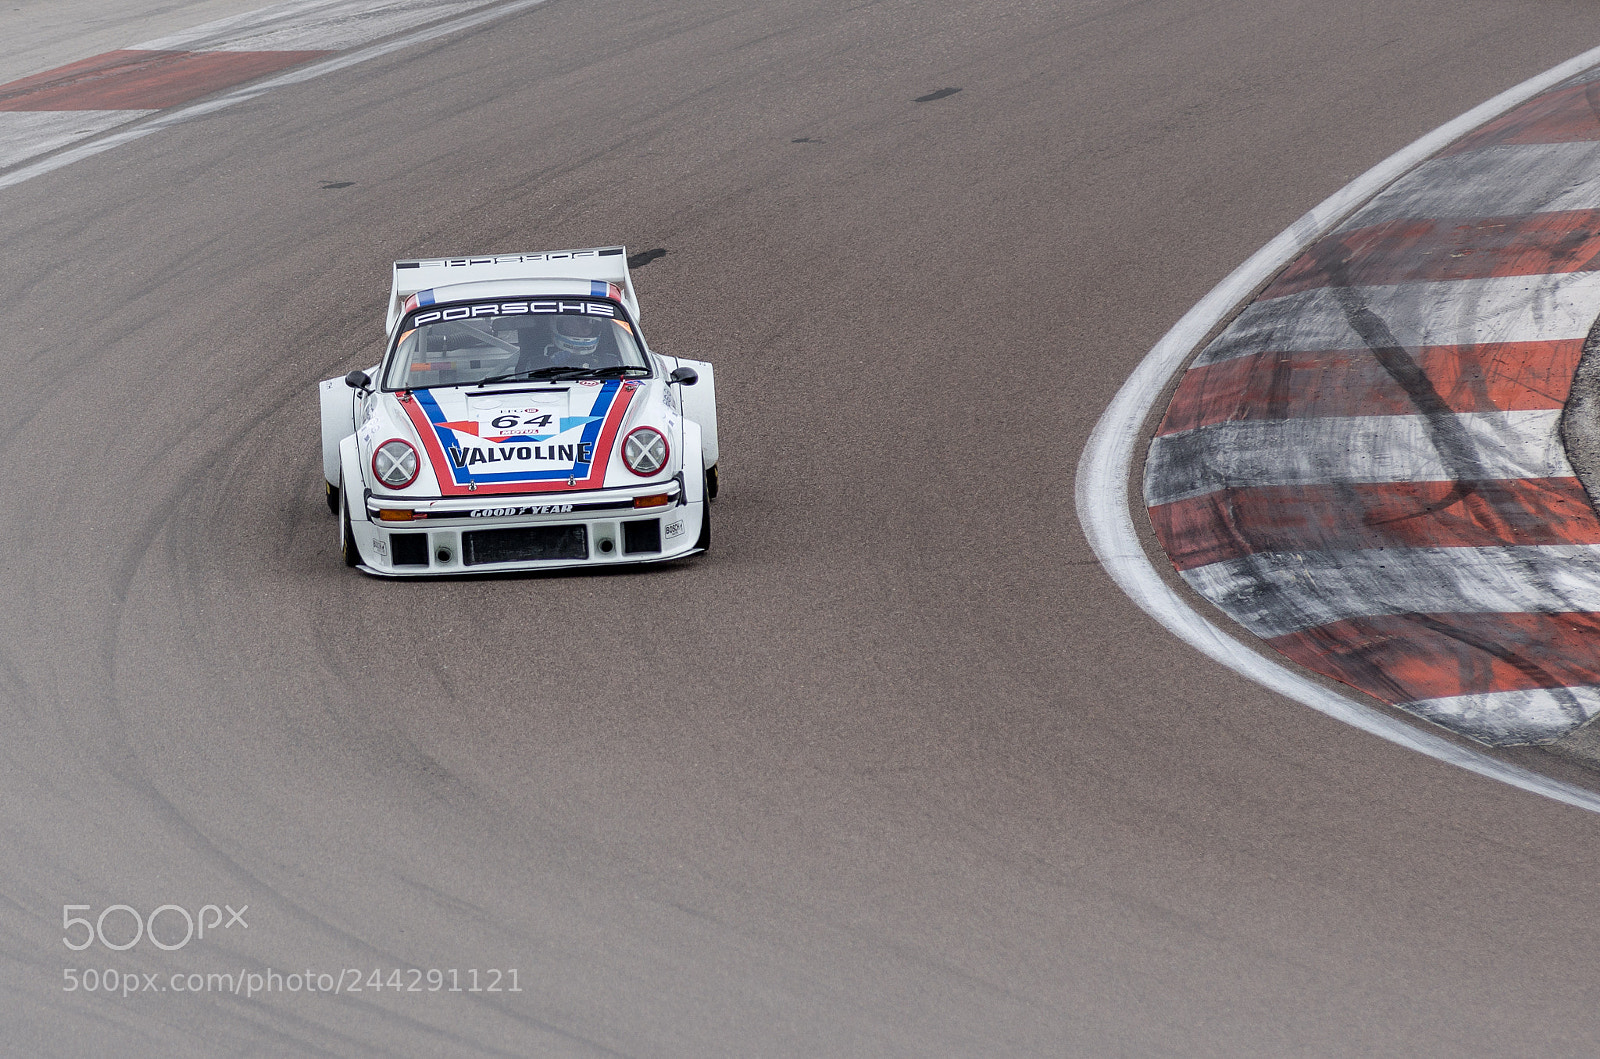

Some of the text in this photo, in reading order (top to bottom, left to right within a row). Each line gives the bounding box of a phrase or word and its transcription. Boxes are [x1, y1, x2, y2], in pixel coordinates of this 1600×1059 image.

[414, 302, 614, 327] PORSCHE
[491, 414, 553, 429] 64
[450, 443, 592, 468] VALVOLINE
[470, 504, 573, 518] GOOD YEAR
